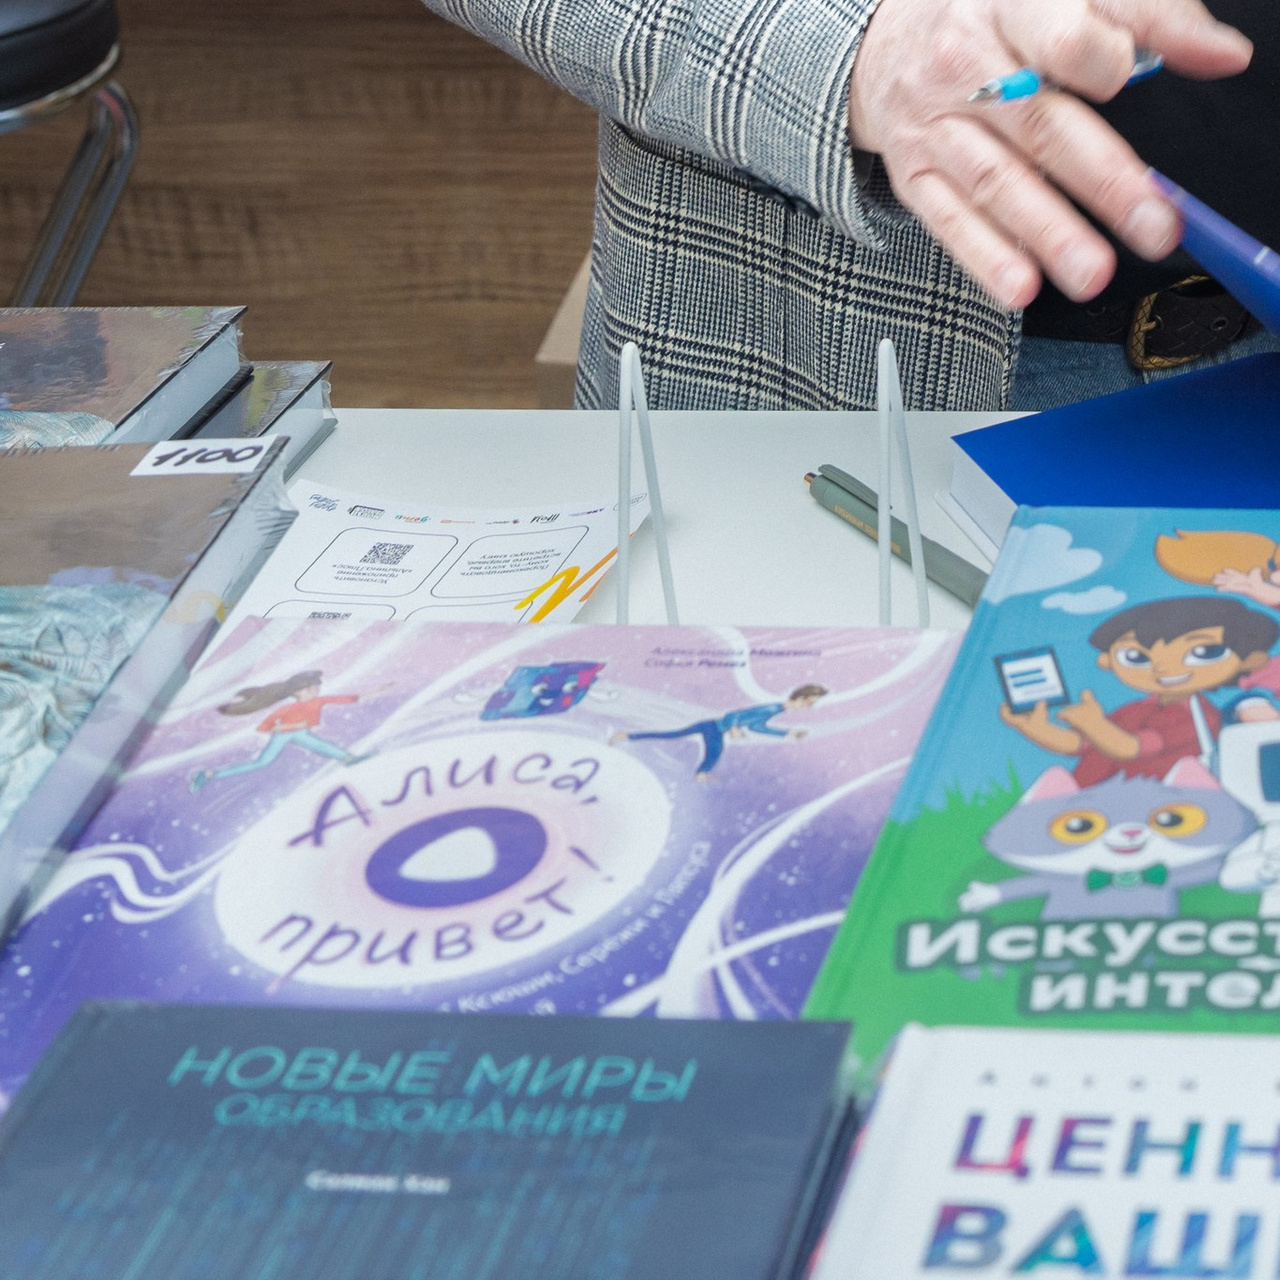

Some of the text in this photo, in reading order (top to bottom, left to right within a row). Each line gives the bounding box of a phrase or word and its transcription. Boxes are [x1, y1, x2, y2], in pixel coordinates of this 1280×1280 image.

[151, 444, 264, 467] 1100
[286, 748, 603, 848] Алиса,
[258, 843, 617, 996] привет!
[167, 1042, 700, 1105] НОВЫЕ МИРЫ
[213, 1090, 630, 1139] ОБРАЗОВАНИЯ
